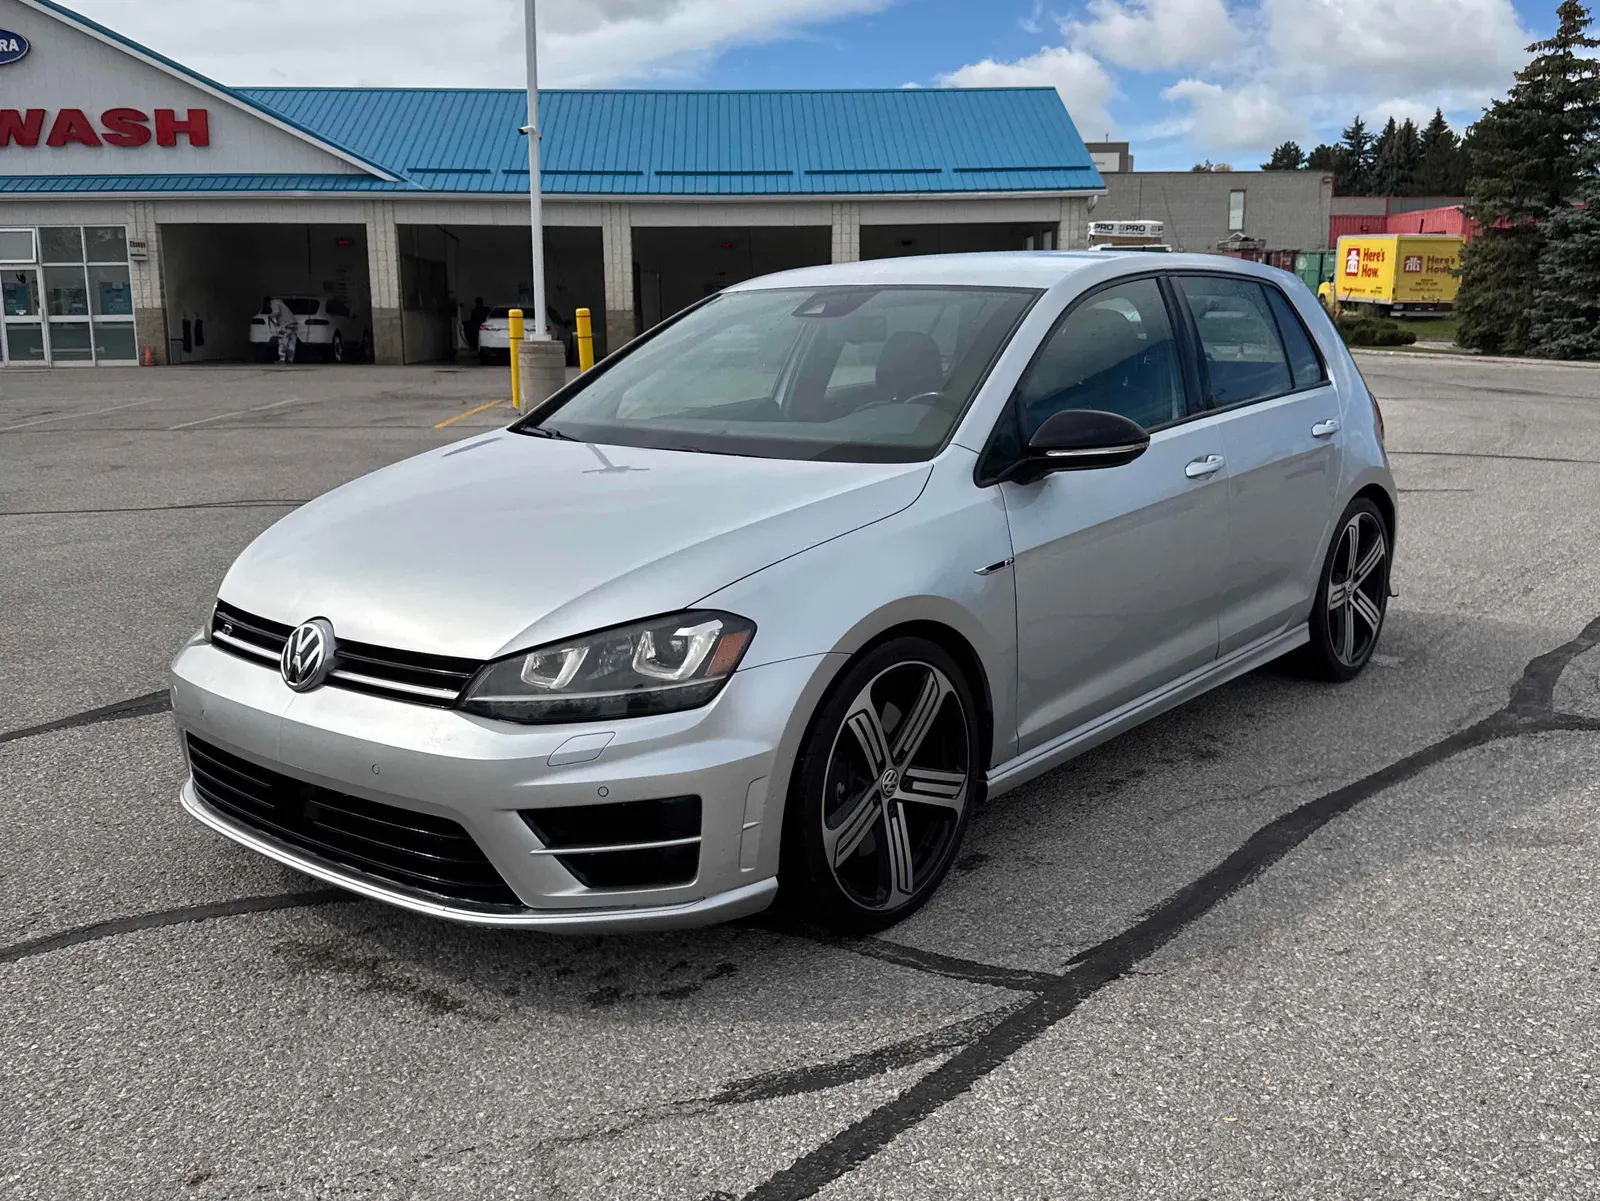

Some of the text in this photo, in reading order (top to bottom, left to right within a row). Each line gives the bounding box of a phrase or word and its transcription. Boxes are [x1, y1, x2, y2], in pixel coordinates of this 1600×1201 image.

[0, 108, 210, 146] WASH
[1095, 223, 1114, 231] PRO
[1125, 224, 1146, 232] PRO
[1363, 248, 1385, 262] Here's
[1427, 255, 1455, 264] Here's
